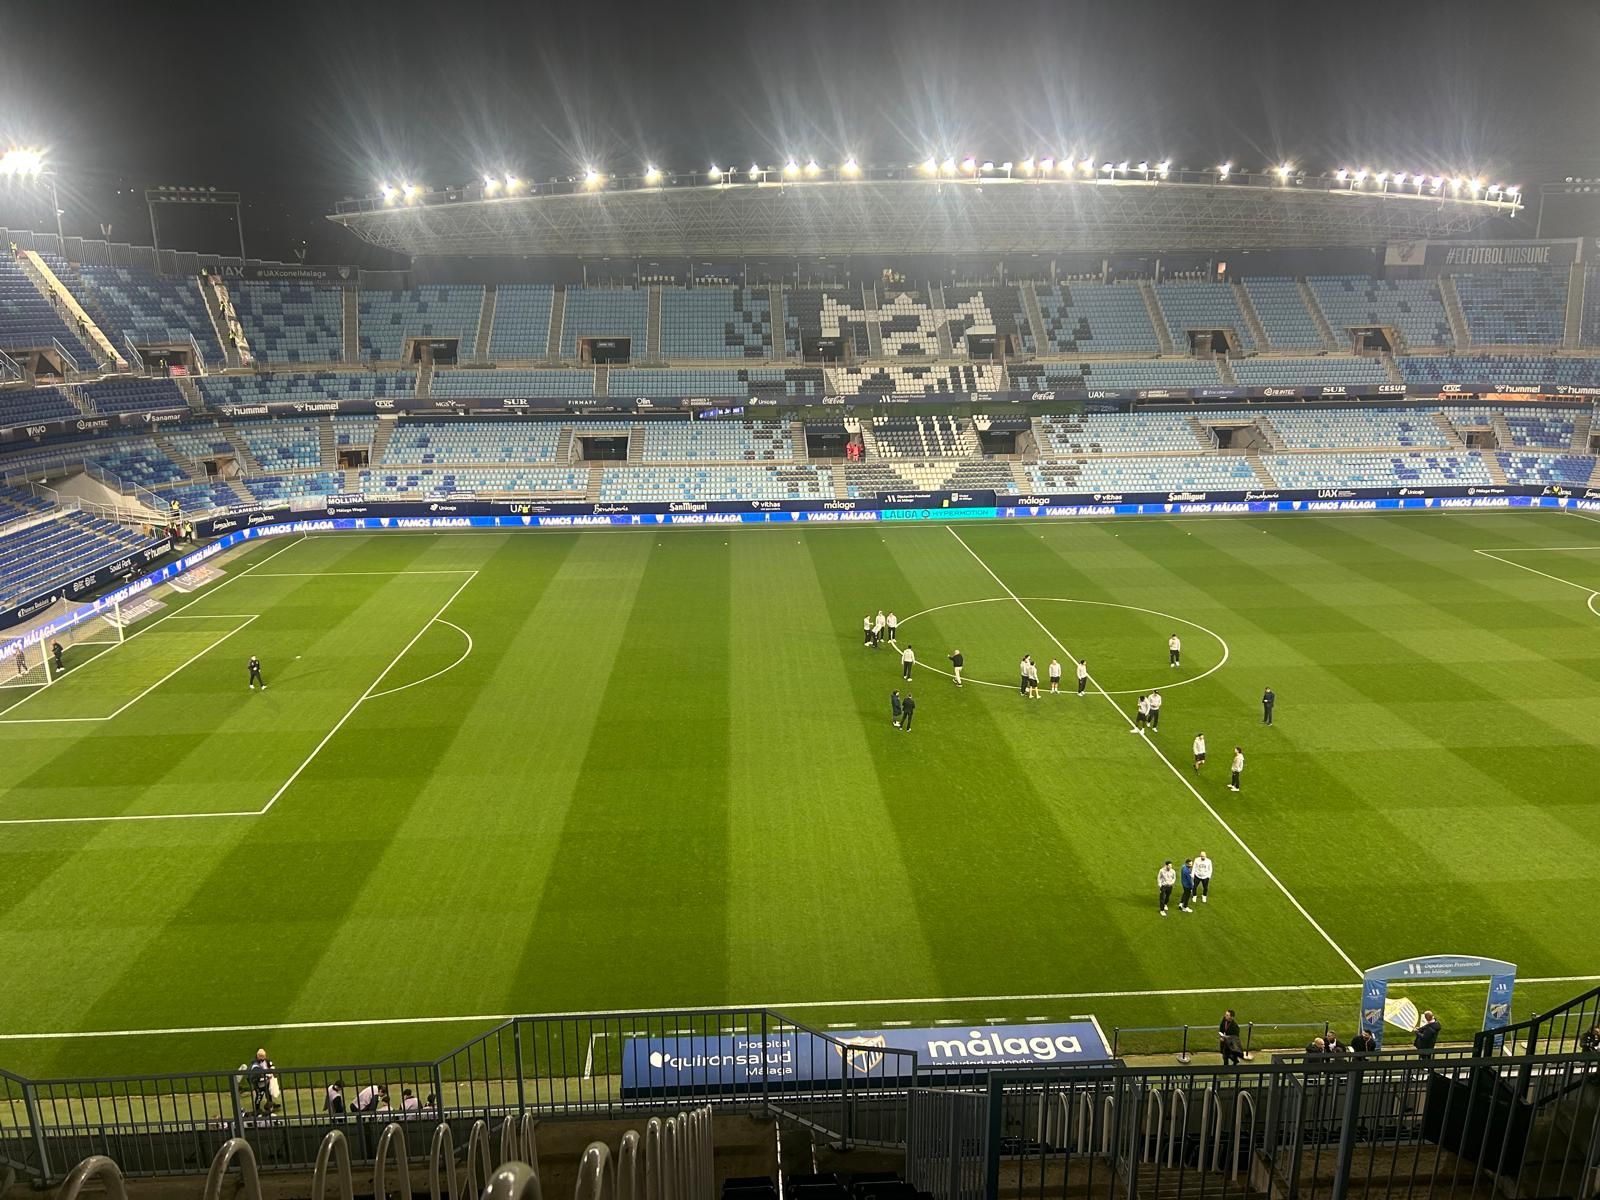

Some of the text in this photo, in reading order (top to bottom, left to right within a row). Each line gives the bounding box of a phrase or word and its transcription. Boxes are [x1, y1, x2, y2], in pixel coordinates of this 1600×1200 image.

[1568, 386, 1600, 394] humme
[234, 406, 268, 415] hummel
[305, 402, 339, 411] hummel
[824, 501, 855, 510] málaga
[1018, 496, 1050, 506] málaga
[1308, 500, 1376, 510] VAMOS MÁLAGA
[1472, 497, 1509, 506] MÁLAGA
[1576, 501, 1600, 510] VAM
[1046, 505, 1115, 515] VAMOS MÁLAGA
[1212, 503, 1250, 512] MÁLAGA
[573, 515, 611, 524] MÁLAGA
[705, 513, 743, 523] MÁLAGA
[840, 511, 877, 520] MÁLAGA
[397, 517, 471, 527] VAMOS MÁLAGA
[256, 521, 334, 536] VAMOS MÁLAGA
[150, 541, 171, 558] hummel
[185, 542, 222, 566] VAMOS MÁLAGA
[129, 578, 152, 594] MÁLAGA
[0, 624, 56, 660] AMOS MÁLAGA
